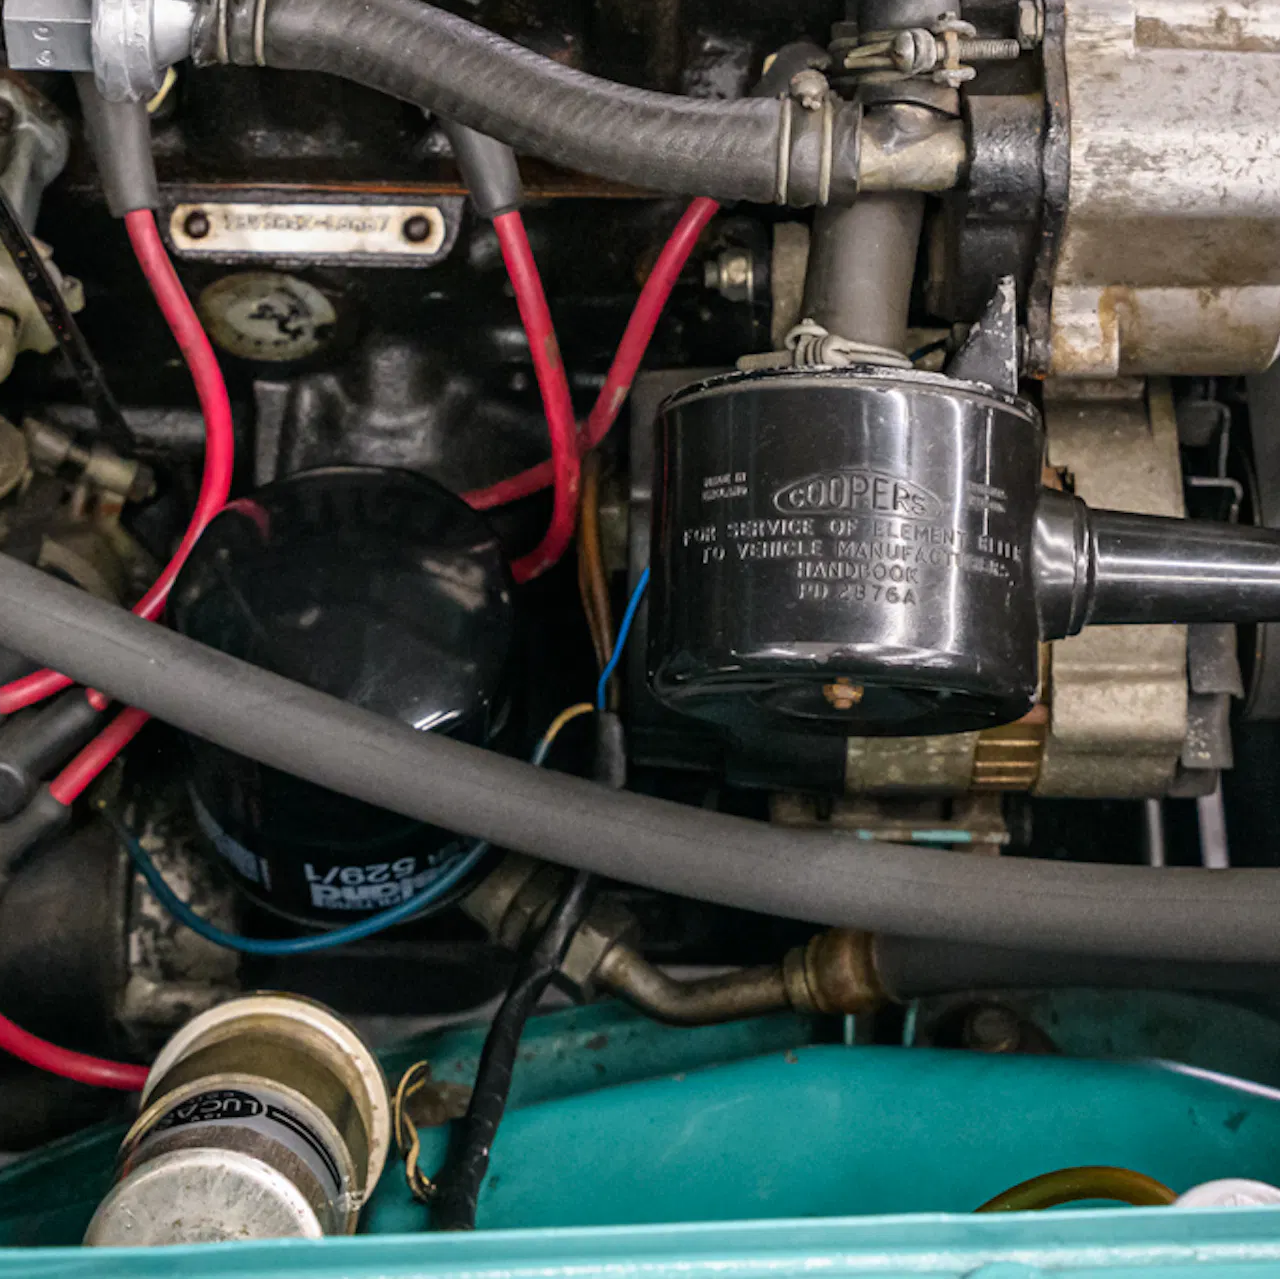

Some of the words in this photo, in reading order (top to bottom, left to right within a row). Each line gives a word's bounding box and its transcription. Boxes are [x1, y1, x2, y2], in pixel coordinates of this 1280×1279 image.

[788, 474, 926, 516] COOPERS
[682, 524, 717, 547] FOR
[726, 518, 816, 538] SERVICE
[829, 518, 859, 537] OF
[873, 519, 968, 547] ELEMENT
[702, 545, 727, 564] TO
[736, 539, 824, 561] VEHICLE
[796, 560, 920, 585] HANDBOOK
